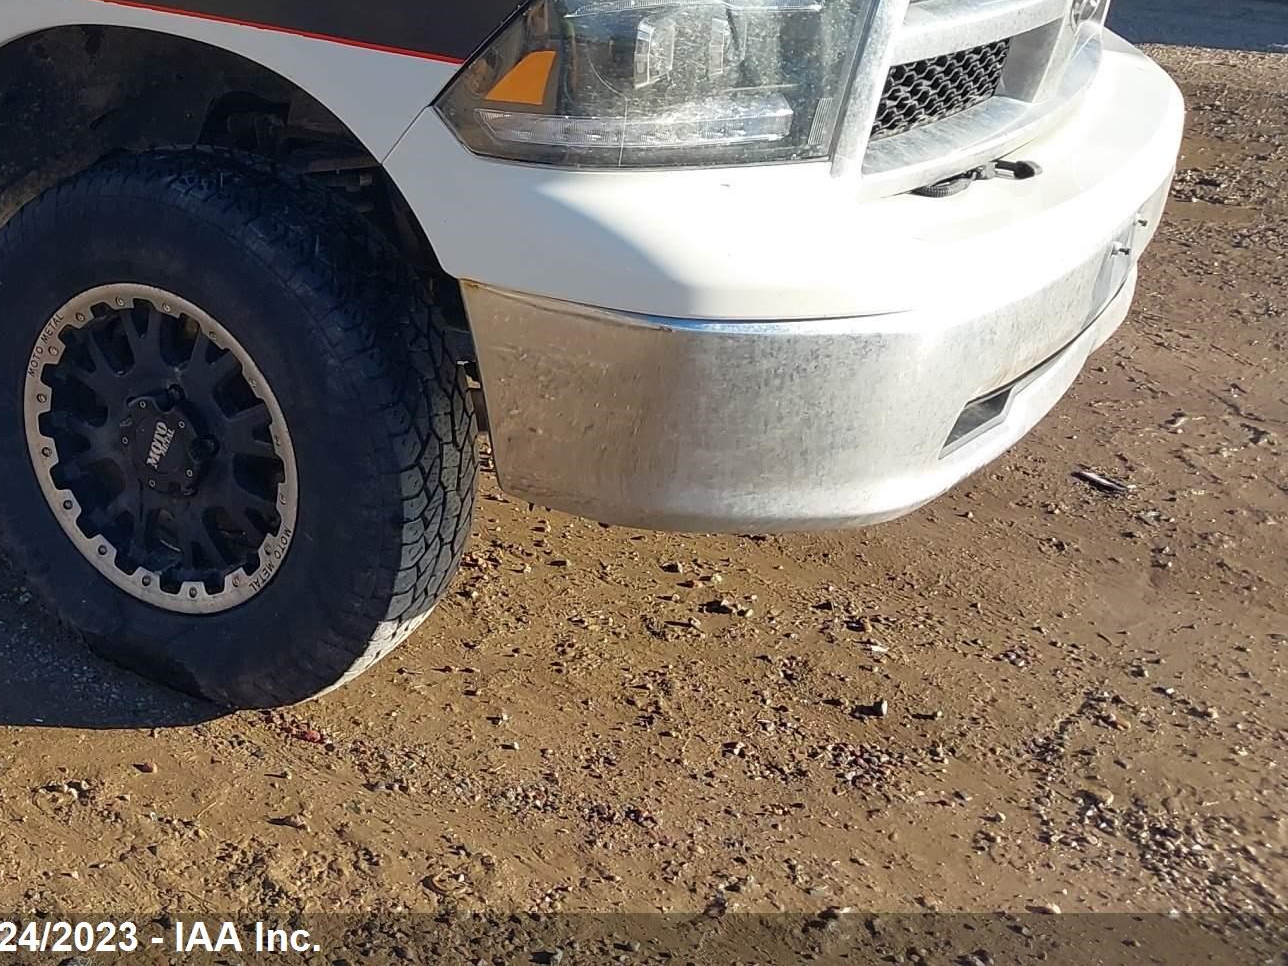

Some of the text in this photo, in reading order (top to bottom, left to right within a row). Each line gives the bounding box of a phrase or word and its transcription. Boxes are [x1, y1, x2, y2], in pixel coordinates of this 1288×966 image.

[27, 313, 65, 377] MOTO METAL
[145, 421, 169, 469] MOTO
[248, 525, 292, 592] MOTO METAL
